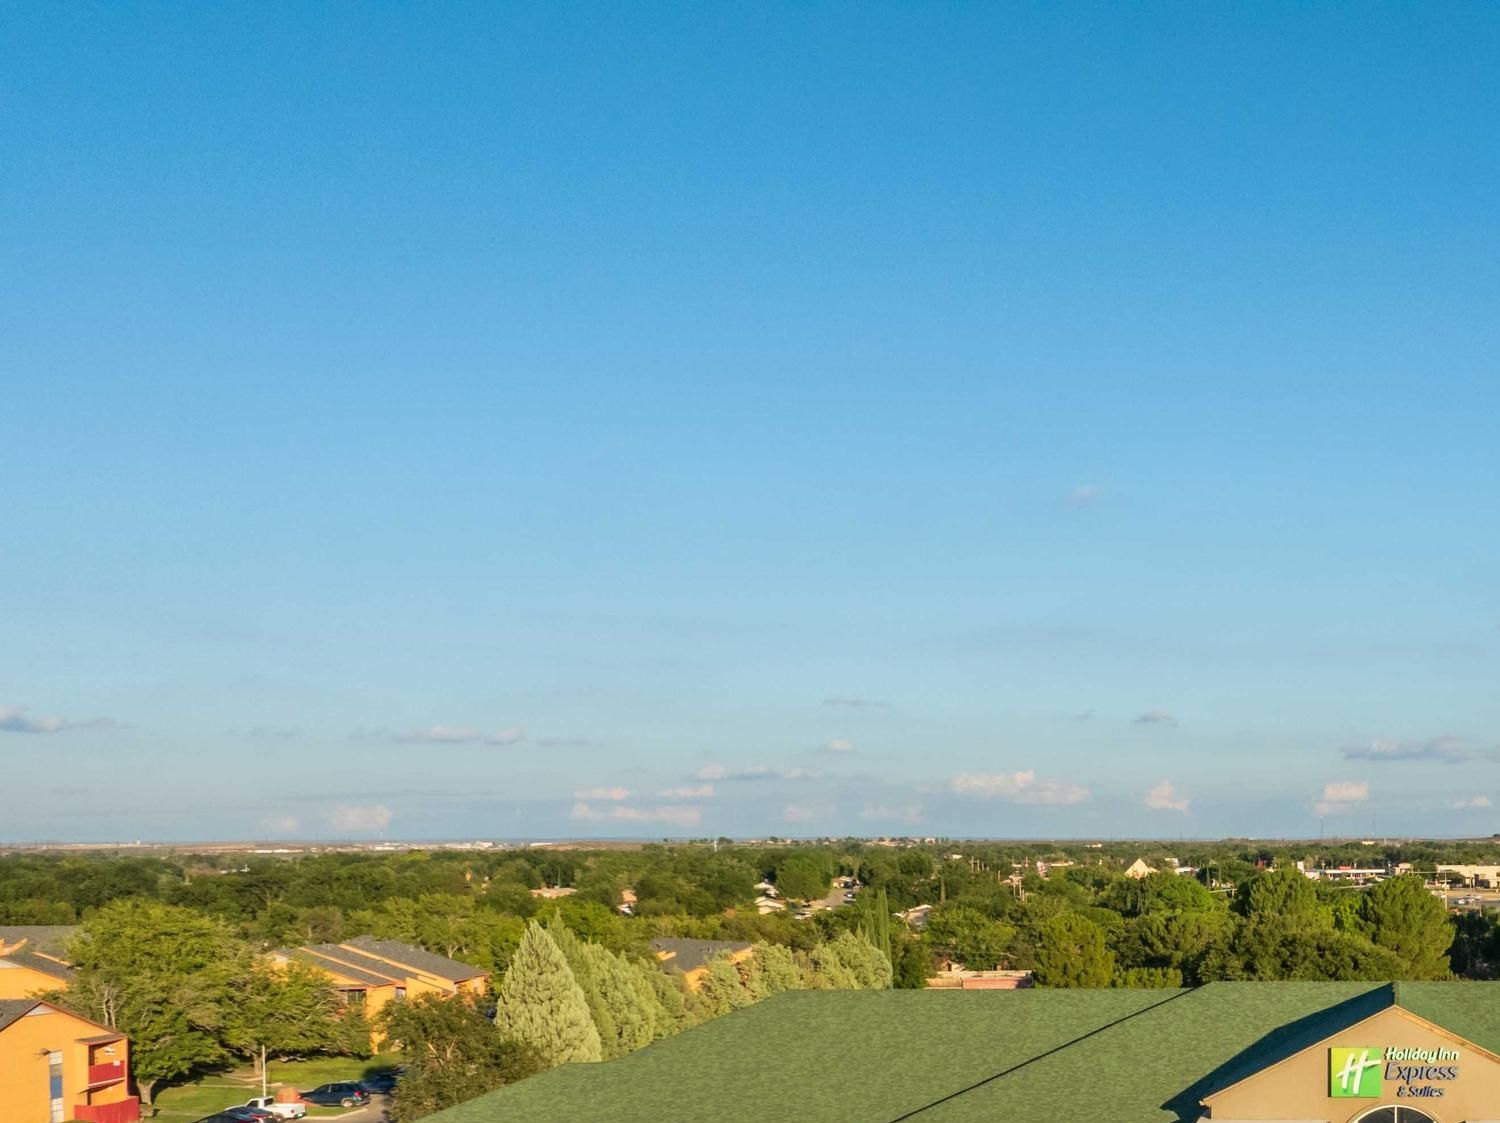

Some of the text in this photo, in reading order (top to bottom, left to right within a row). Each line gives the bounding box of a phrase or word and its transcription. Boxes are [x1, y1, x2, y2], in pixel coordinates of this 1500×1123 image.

[1385, 1047, 1459, 1063] Holiday Inn
[1384, 1062, 1458, 1085] Express
[1397, 1085, 1444, 1097] & Suites
